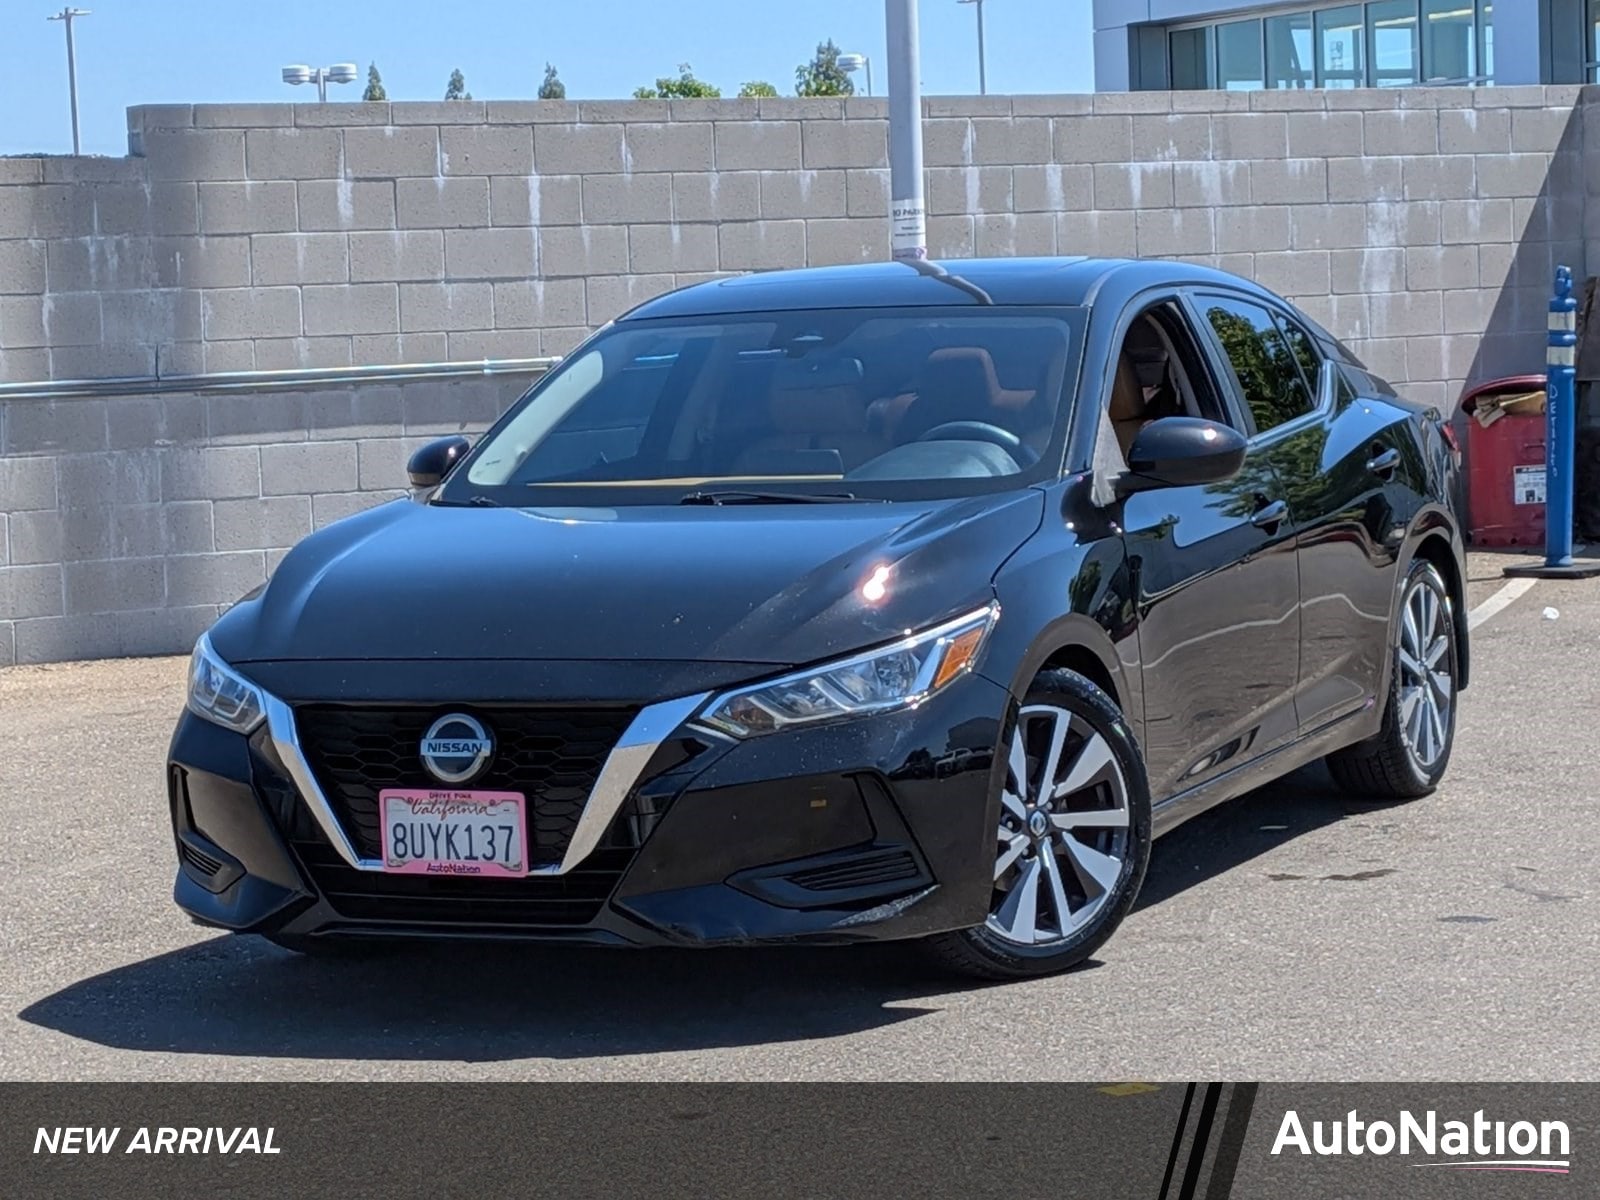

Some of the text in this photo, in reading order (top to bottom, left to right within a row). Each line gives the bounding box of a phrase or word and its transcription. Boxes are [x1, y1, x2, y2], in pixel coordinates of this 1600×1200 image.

[427, 742, 483, 753] NISSAN
[410, 798, 497, 821] California
[392, 822, 514, 862] 8UYK137
[426, 863, 481, 874] AutoNation
